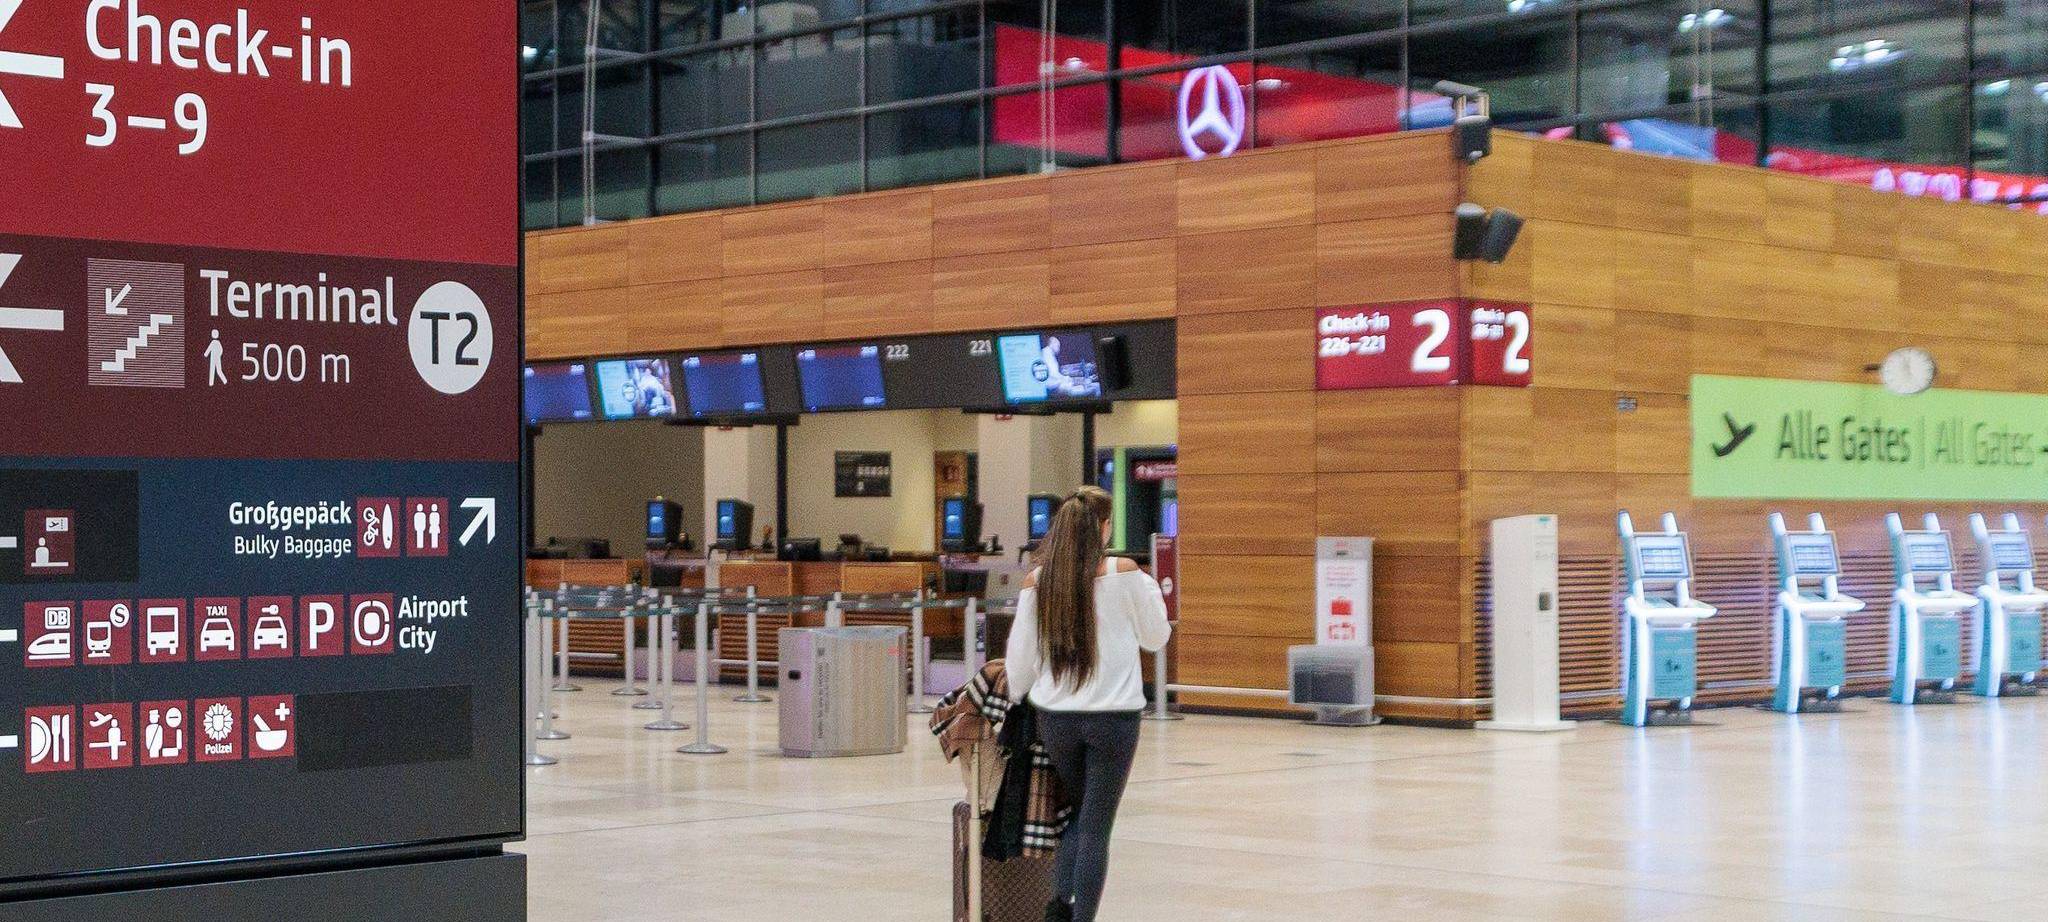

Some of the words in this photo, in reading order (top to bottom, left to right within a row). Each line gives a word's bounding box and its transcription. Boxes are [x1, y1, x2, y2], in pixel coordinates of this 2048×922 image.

[85, 0, 352, 88] Check-in
[85, 83, 208, 155] 3–9
[199, 269, 398, 326] Terminal
[420, 311, 479, 366] T2
[886, 344, 910, 360] 222
[969, 339, 992, 356] 221
[1412, 309, 1450, 371] 2
[1503, 310, 1530, 373] 2
[241, 342, 306, 383] 500
[321, 353, 350, 384] m
[1777, 410, 1831, 461] Alle
[1840, 415, 1912, 464] Gates
[229, 500, 352, 531] Großgepäck
[234, 534, 280, 559] Bulky
[284, 535, 352, 559] Baggage
[48, 610, 68, 625] DB
[113, 606, 127, 625] S
[205, 605, 228, 617] TAXI
[398, 594, 468, 624] Airport
[308, 601, 335, 650] P
[399, 624, 437, 655] City
[204, 742, 233, 755] Polizei
